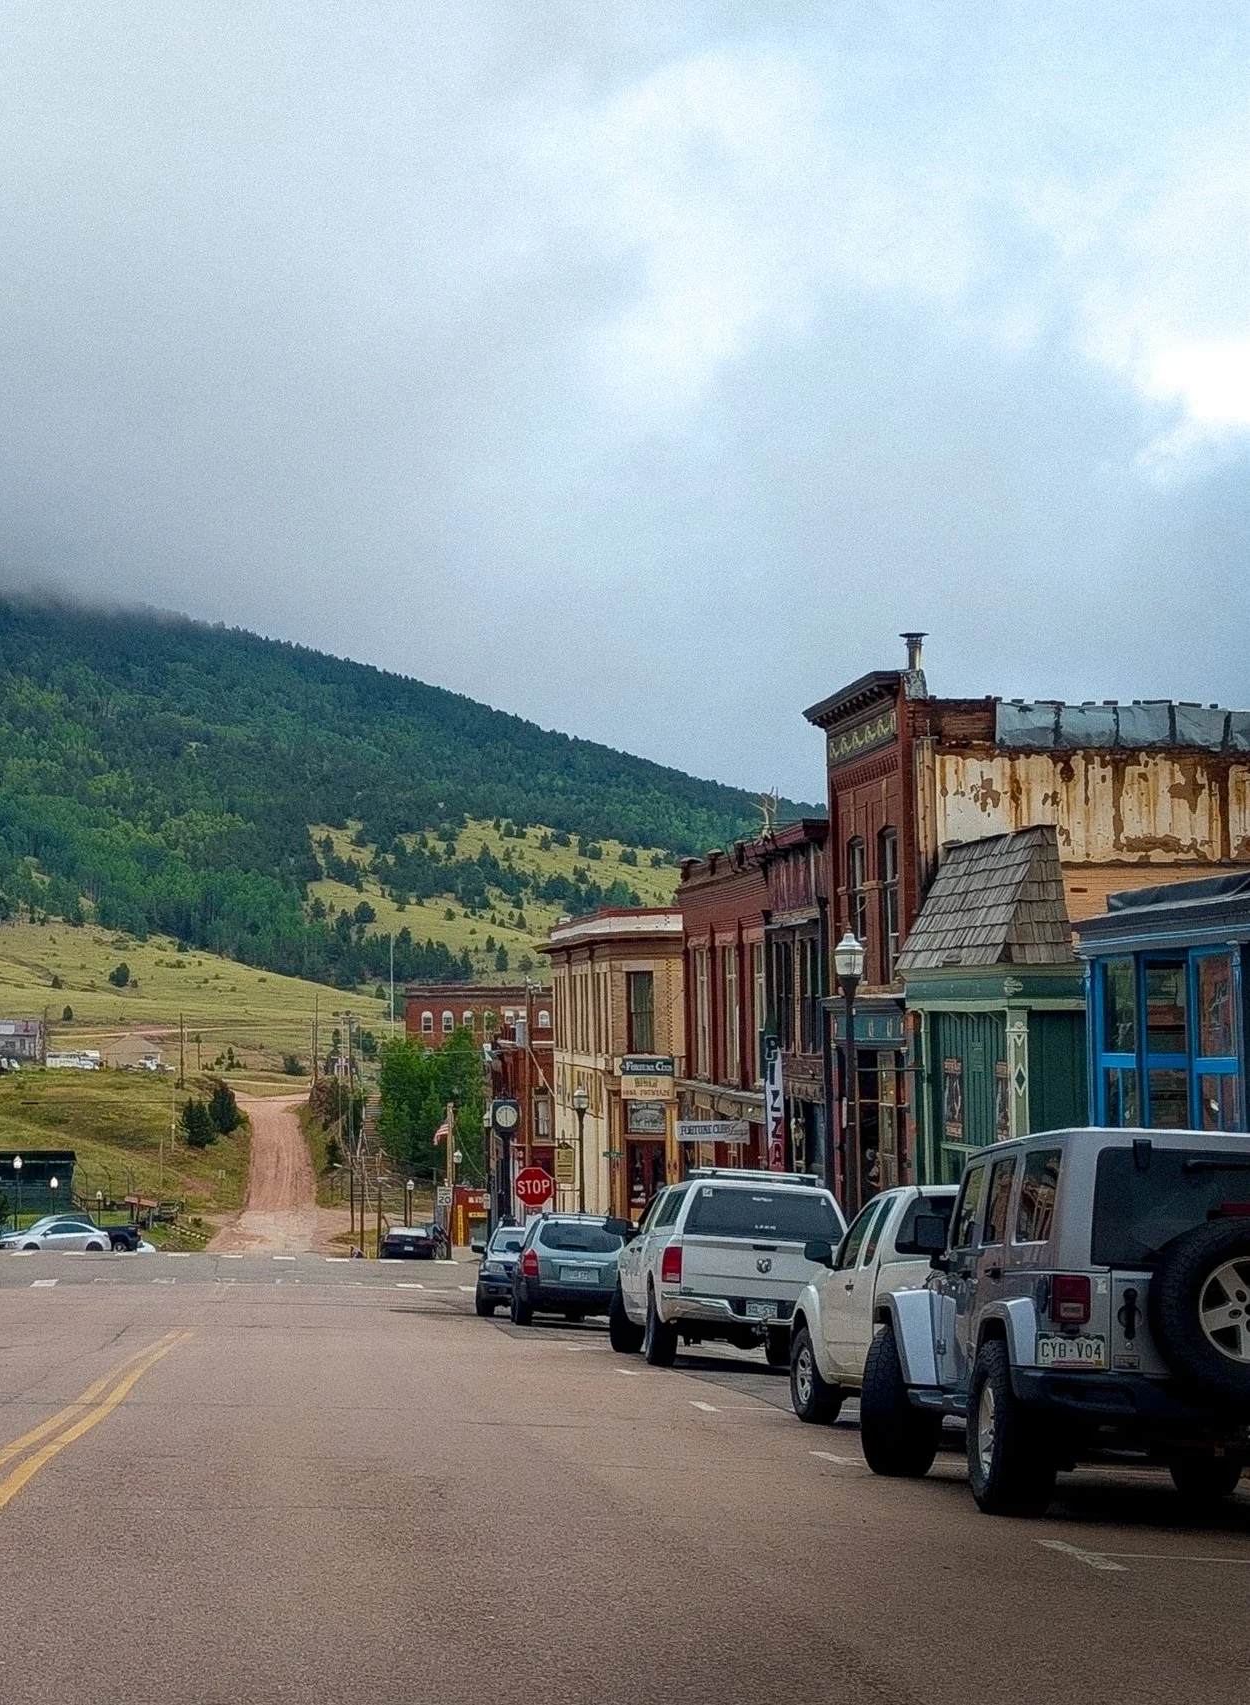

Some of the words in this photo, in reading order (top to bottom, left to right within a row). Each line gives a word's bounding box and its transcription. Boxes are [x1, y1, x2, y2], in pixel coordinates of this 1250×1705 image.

[765, 1035, 783, 1166] PIZZA
[679, 1124, 712, 1136] FORTUNE
[517, 1179, 550, 1195] STOP
[438, 1195, 452, 1204] 20
